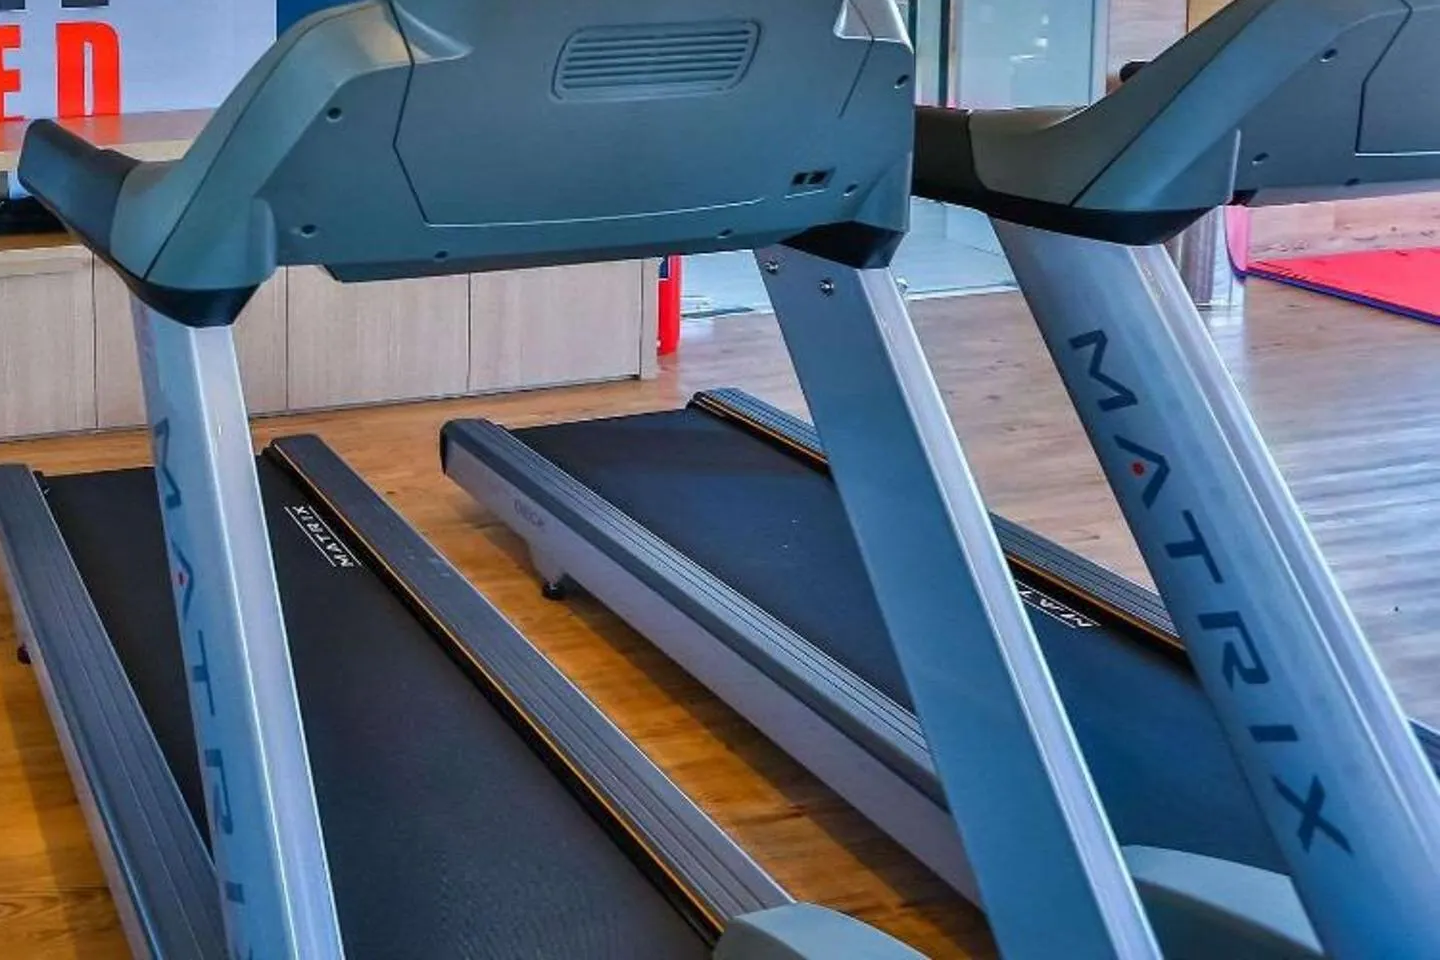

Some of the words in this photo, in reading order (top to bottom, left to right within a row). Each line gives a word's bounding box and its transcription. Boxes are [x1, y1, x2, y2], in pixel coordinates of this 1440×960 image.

[155, 416, 254, 960] MATRI
[292, 506, 354, 567] MATRIX
[1068, 329, 1354, 856] MATRIX
